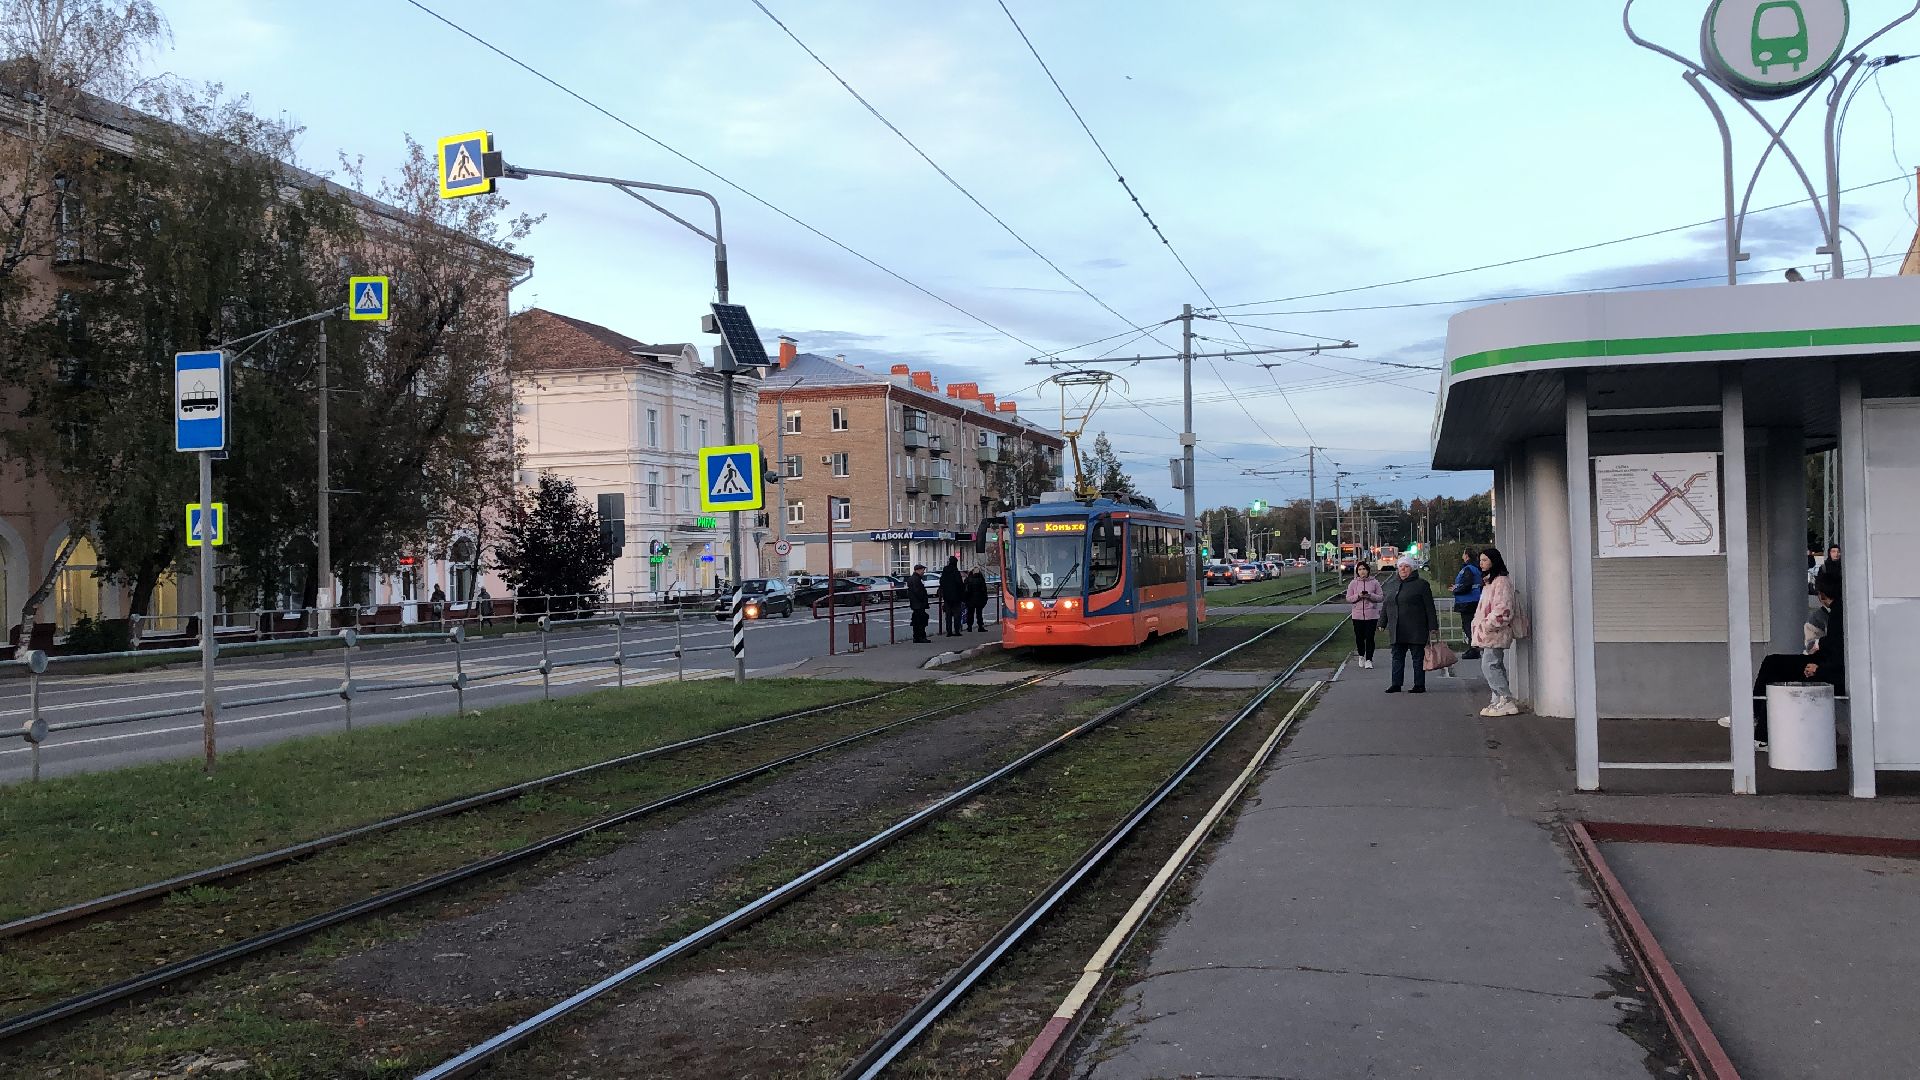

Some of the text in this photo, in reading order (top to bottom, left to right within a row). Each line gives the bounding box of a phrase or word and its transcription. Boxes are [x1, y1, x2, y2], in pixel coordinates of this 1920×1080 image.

[1016, 523, 1025, 535] 3
[875, 532, 914, 540] АДВОКАТ
[1044, 576, 1051, 586] 3
